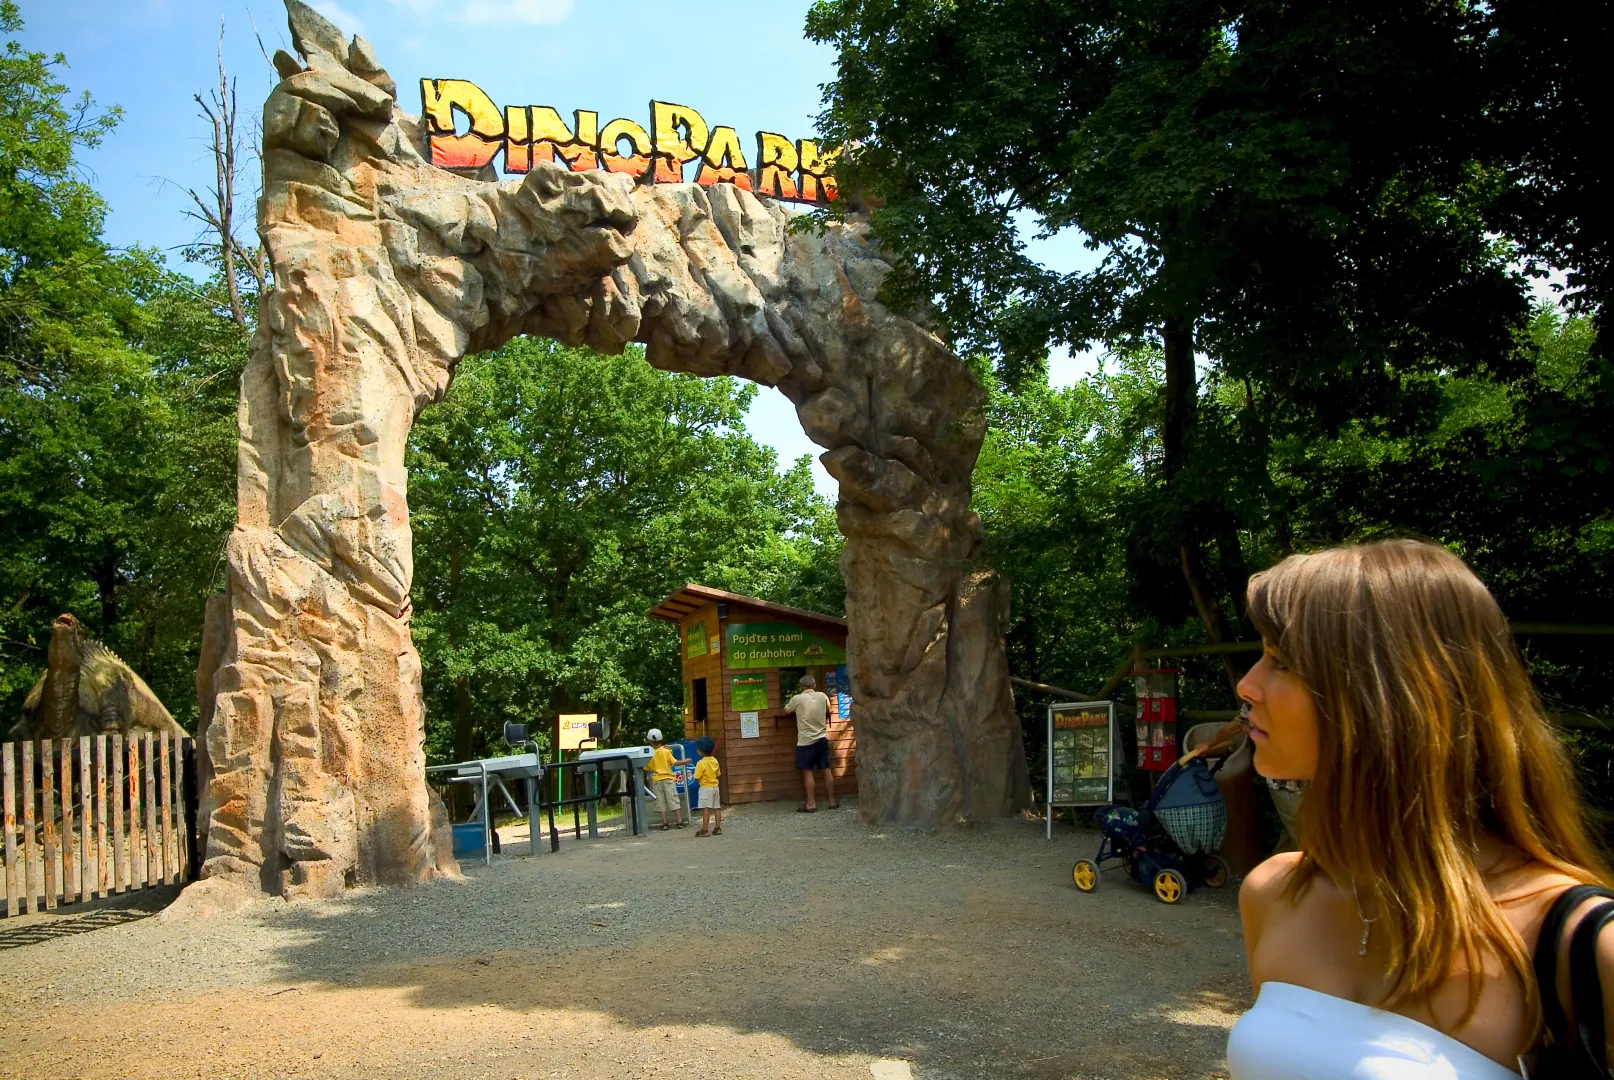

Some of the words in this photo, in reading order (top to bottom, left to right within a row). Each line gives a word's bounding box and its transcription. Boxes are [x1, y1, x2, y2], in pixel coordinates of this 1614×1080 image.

[732, 633, 768, 645] Pojďte
[770, 635, 776, 643] s
[778, 632, 803, 642] námi
[733, 650, 746, 660] do
[749, 649, 797, 660] druhohor
